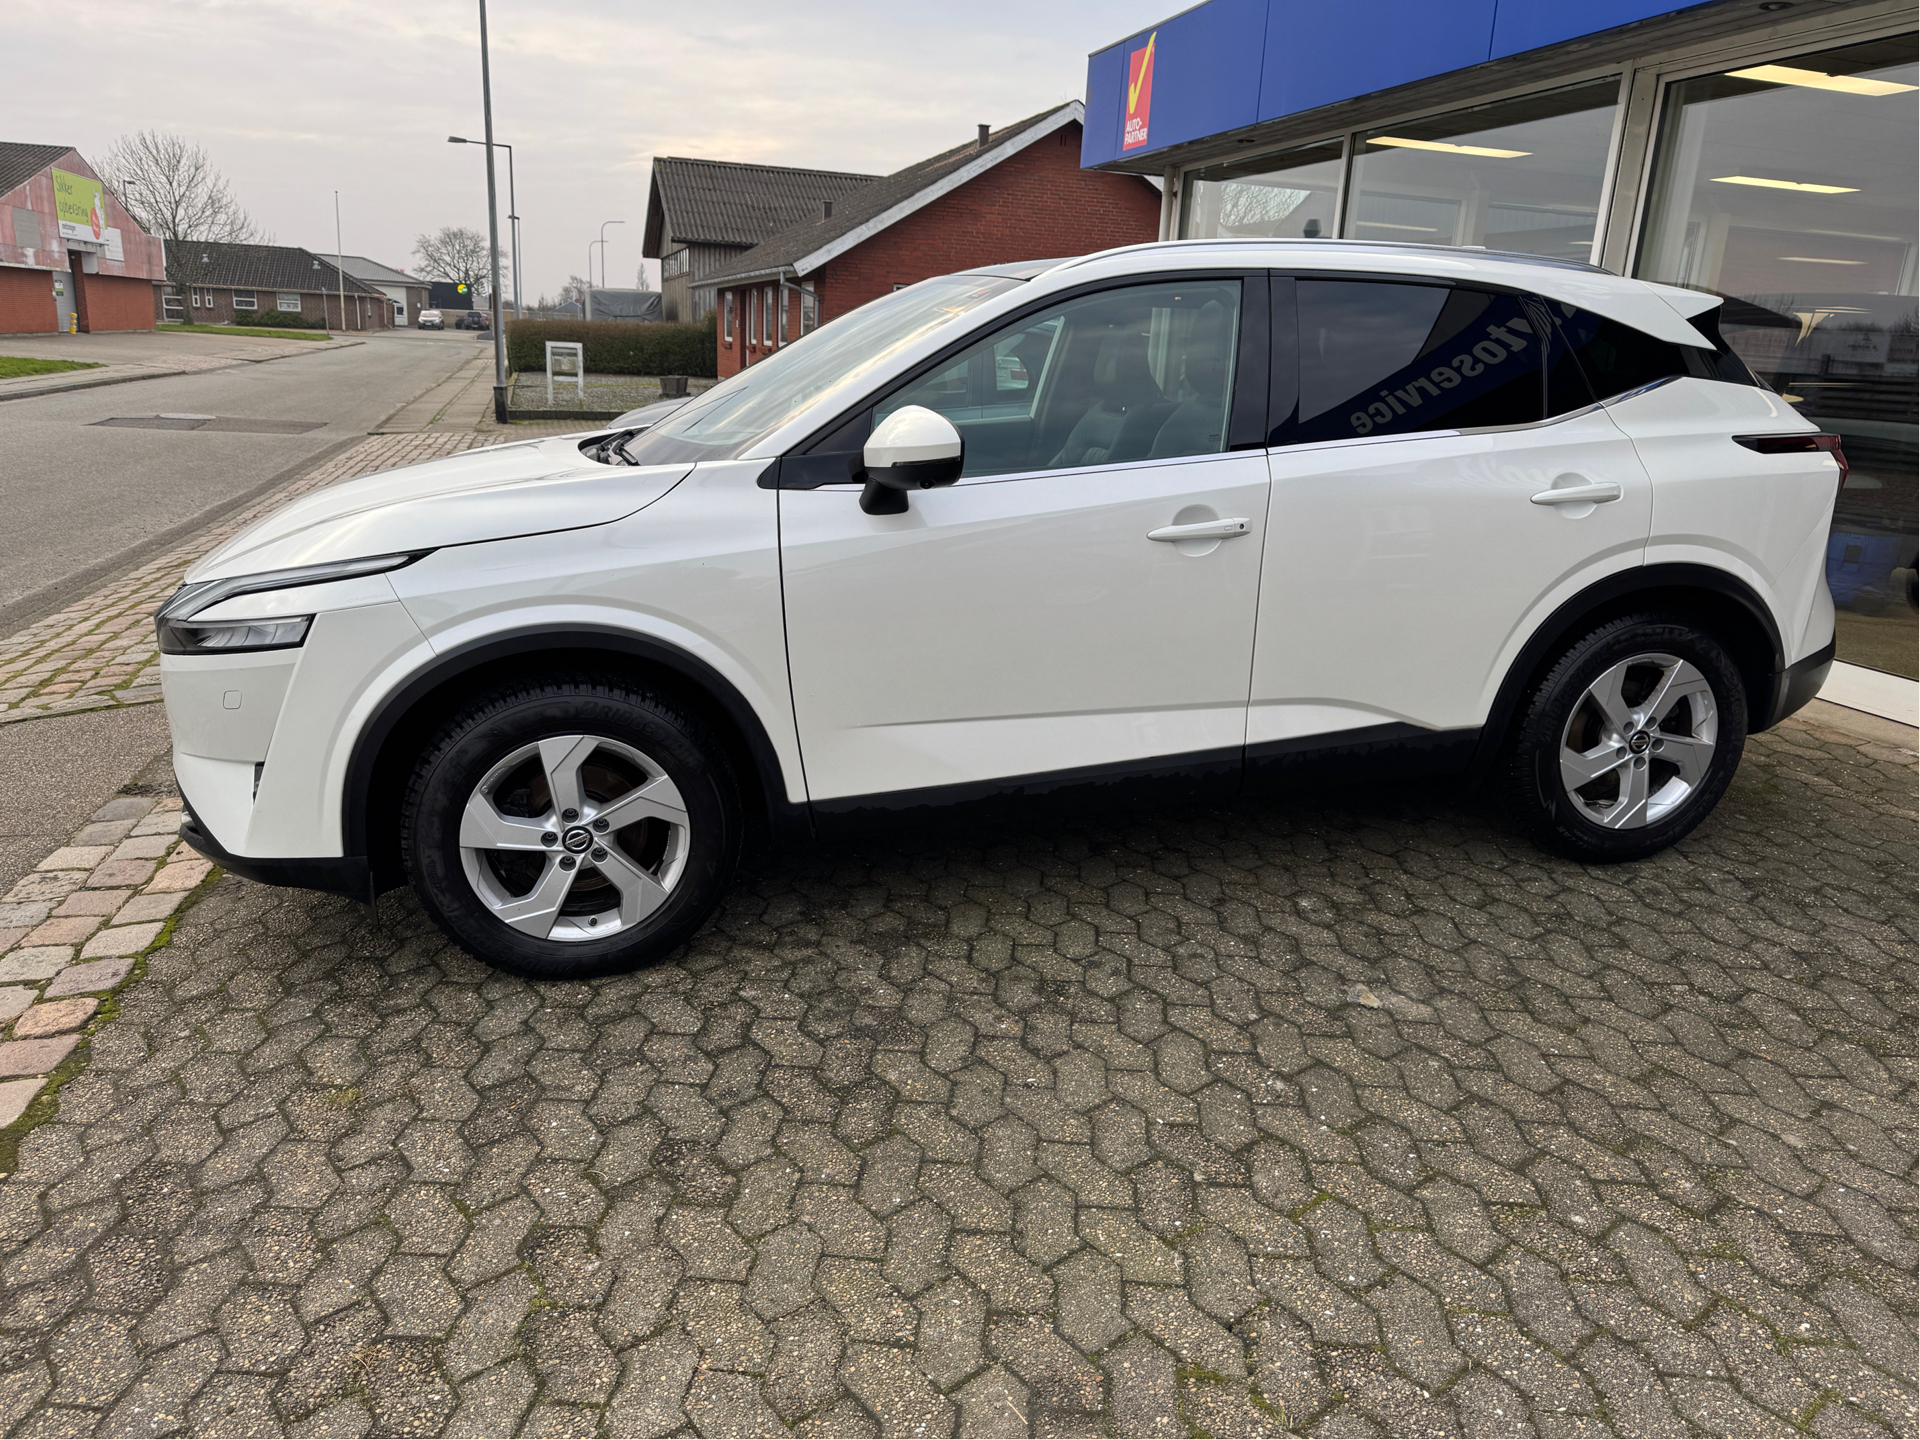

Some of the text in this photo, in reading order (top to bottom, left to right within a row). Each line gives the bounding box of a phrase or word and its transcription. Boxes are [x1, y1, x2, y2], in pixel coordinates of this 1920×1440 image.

[1126, 117, 1142, 132] AUTO-
[1124, 127, 1147, 145] PARTNER
[56, 175, 73, 195] Sikker
[58, 197, 89, 223] opbevaring
[579, 701, 705, 774] BRIDGESTONE
